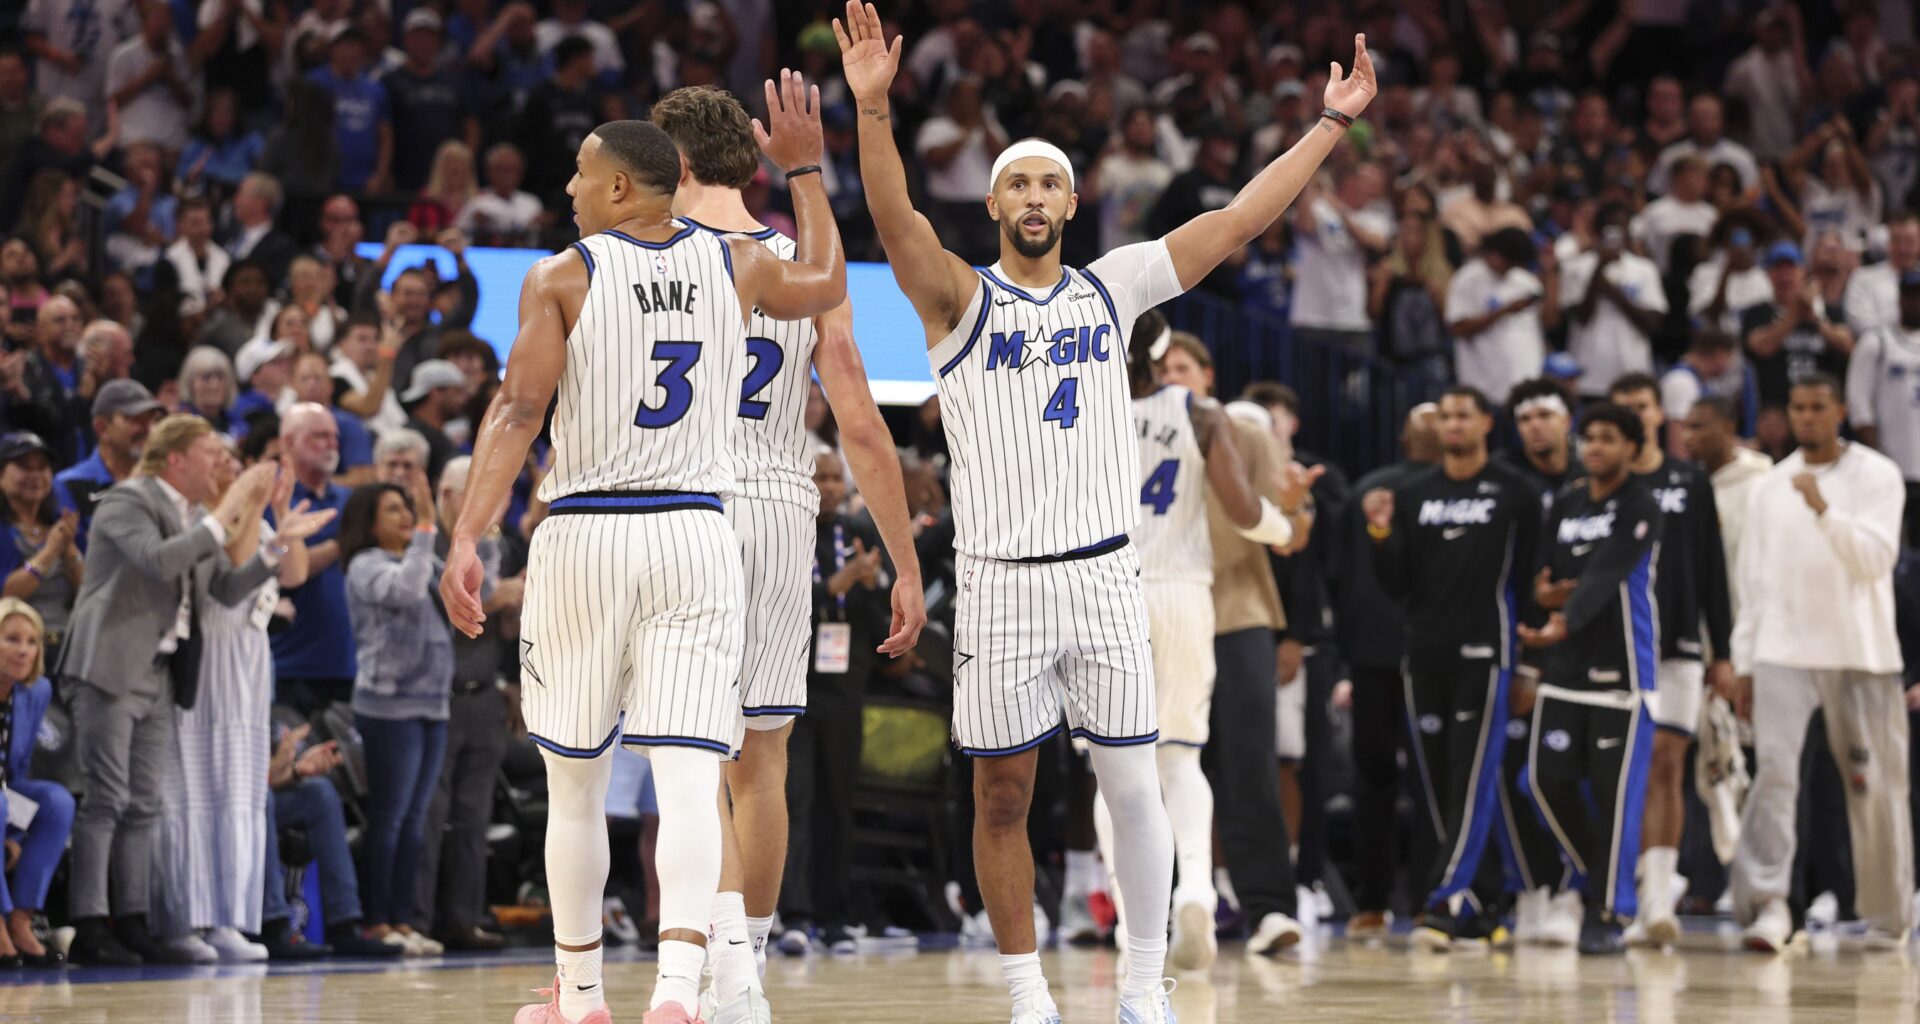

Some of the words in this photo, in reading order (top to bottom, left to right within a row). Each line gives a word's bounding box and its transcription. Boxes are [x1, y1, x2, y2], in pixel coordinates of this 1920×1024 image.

[633, 281, 697, 314] BANE
[1066, 291, 1096, 302] Disney
[634, 340, 703, 429] 3
[738, 337, 784, 420] 2
[1043, 377, 1079, 429] 4
[1140, 459, 1180, 515] 4
